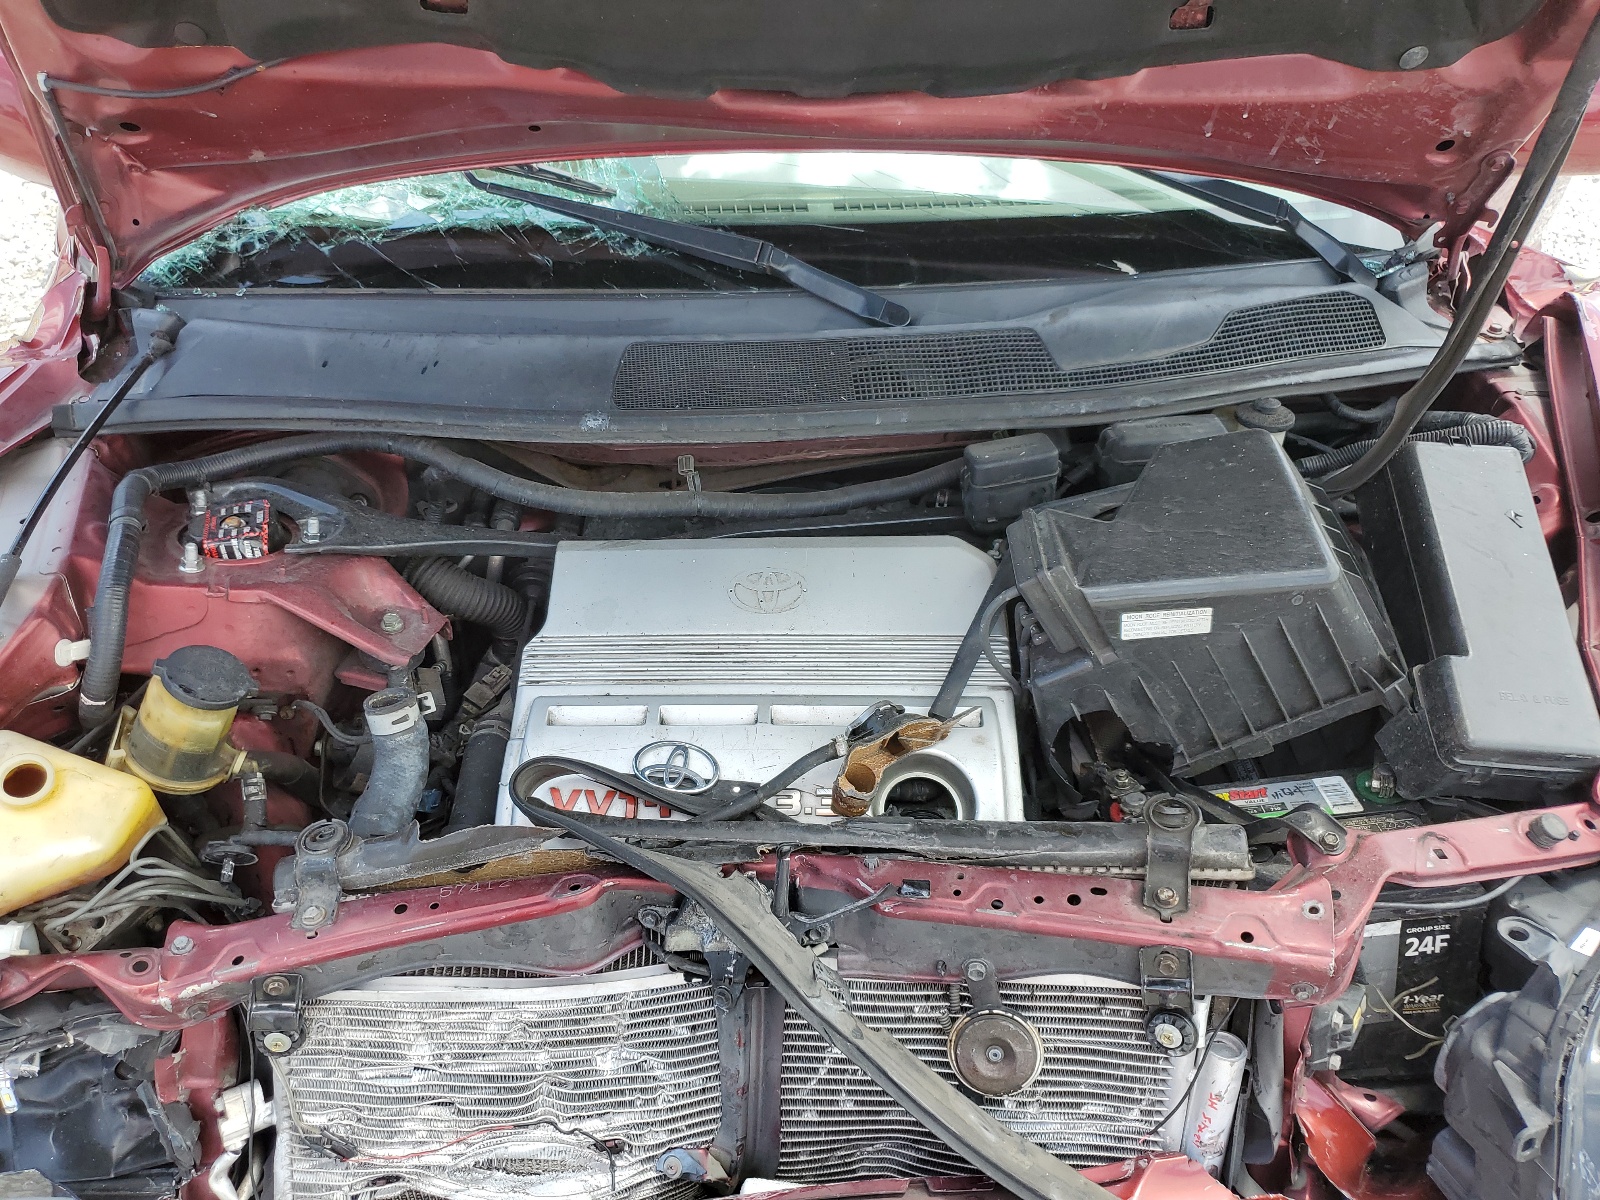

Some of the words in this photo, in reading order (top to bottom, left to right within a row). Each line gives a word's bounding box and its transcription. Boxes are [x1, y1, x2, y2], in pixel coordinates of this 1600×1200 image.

[1215, 787, 1268, 802] erStart
[1404, 934, 1450, 957] 24F
[1403, 993, 1444, 1003] 1-Year
